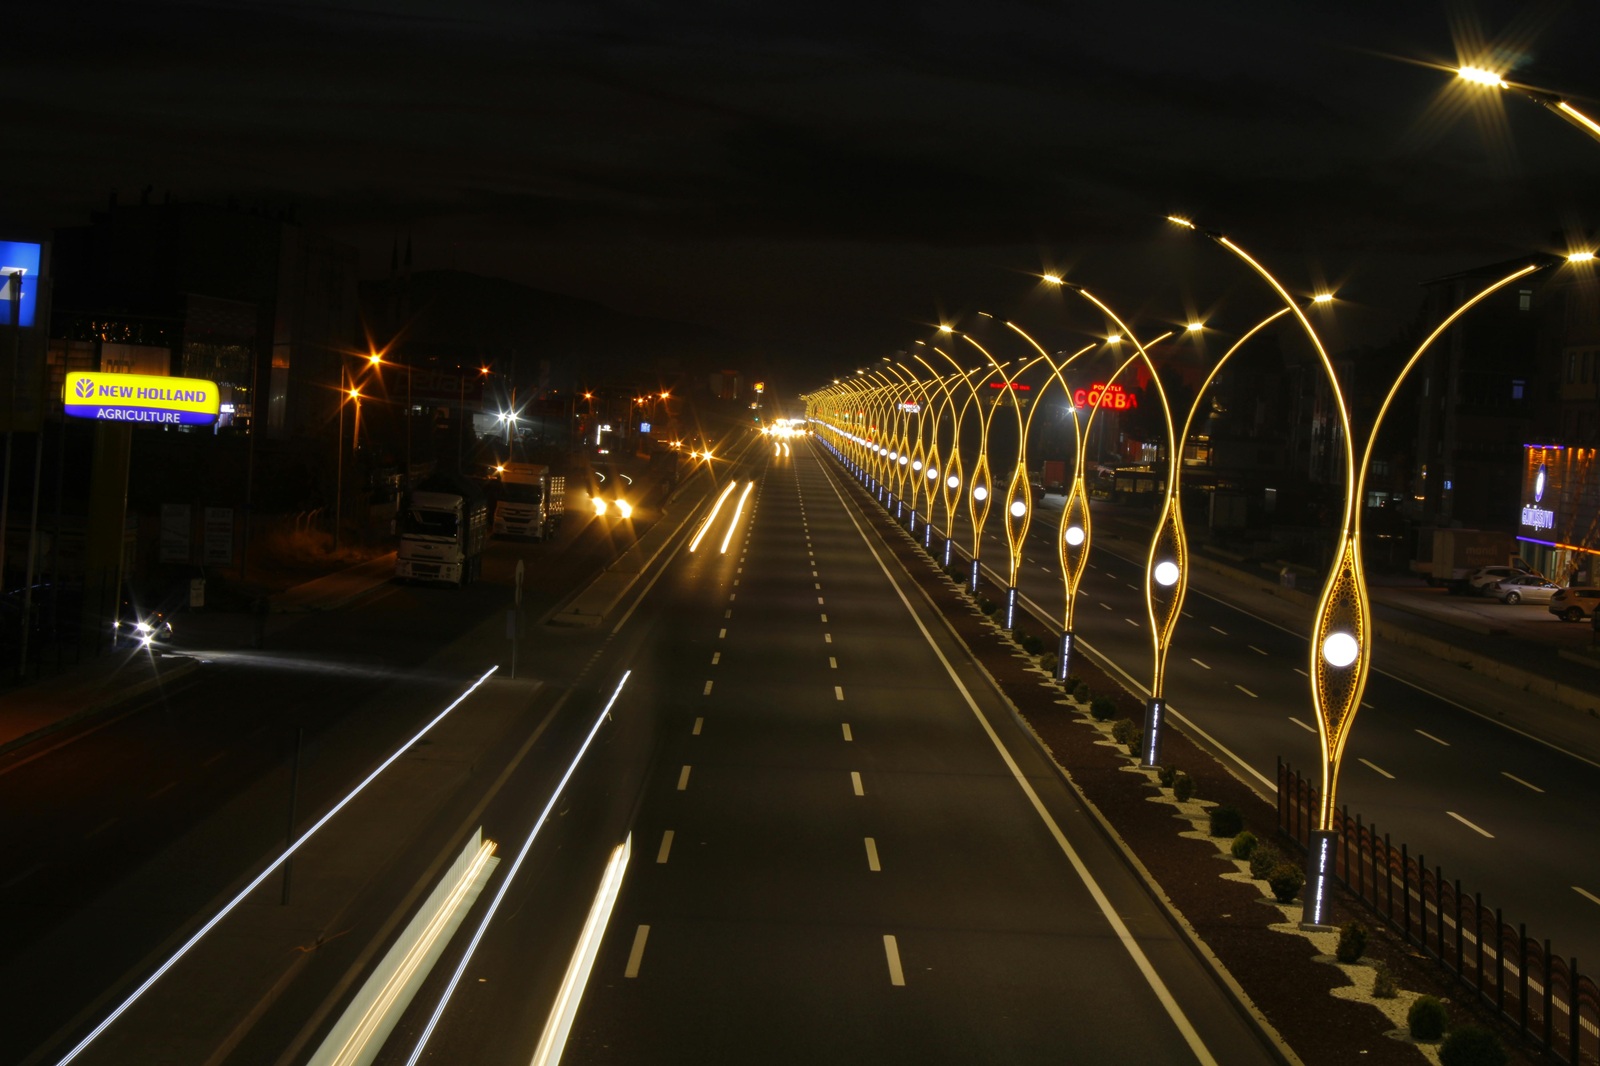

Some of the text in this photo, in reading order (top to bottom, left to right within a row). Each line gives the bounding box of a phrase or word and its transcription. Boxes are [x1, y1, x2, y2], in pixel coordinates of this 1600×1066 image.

[98, 385, 207, 403] NEW HOLLAND
[97, 408, 181, 424] AGRICULTURE
